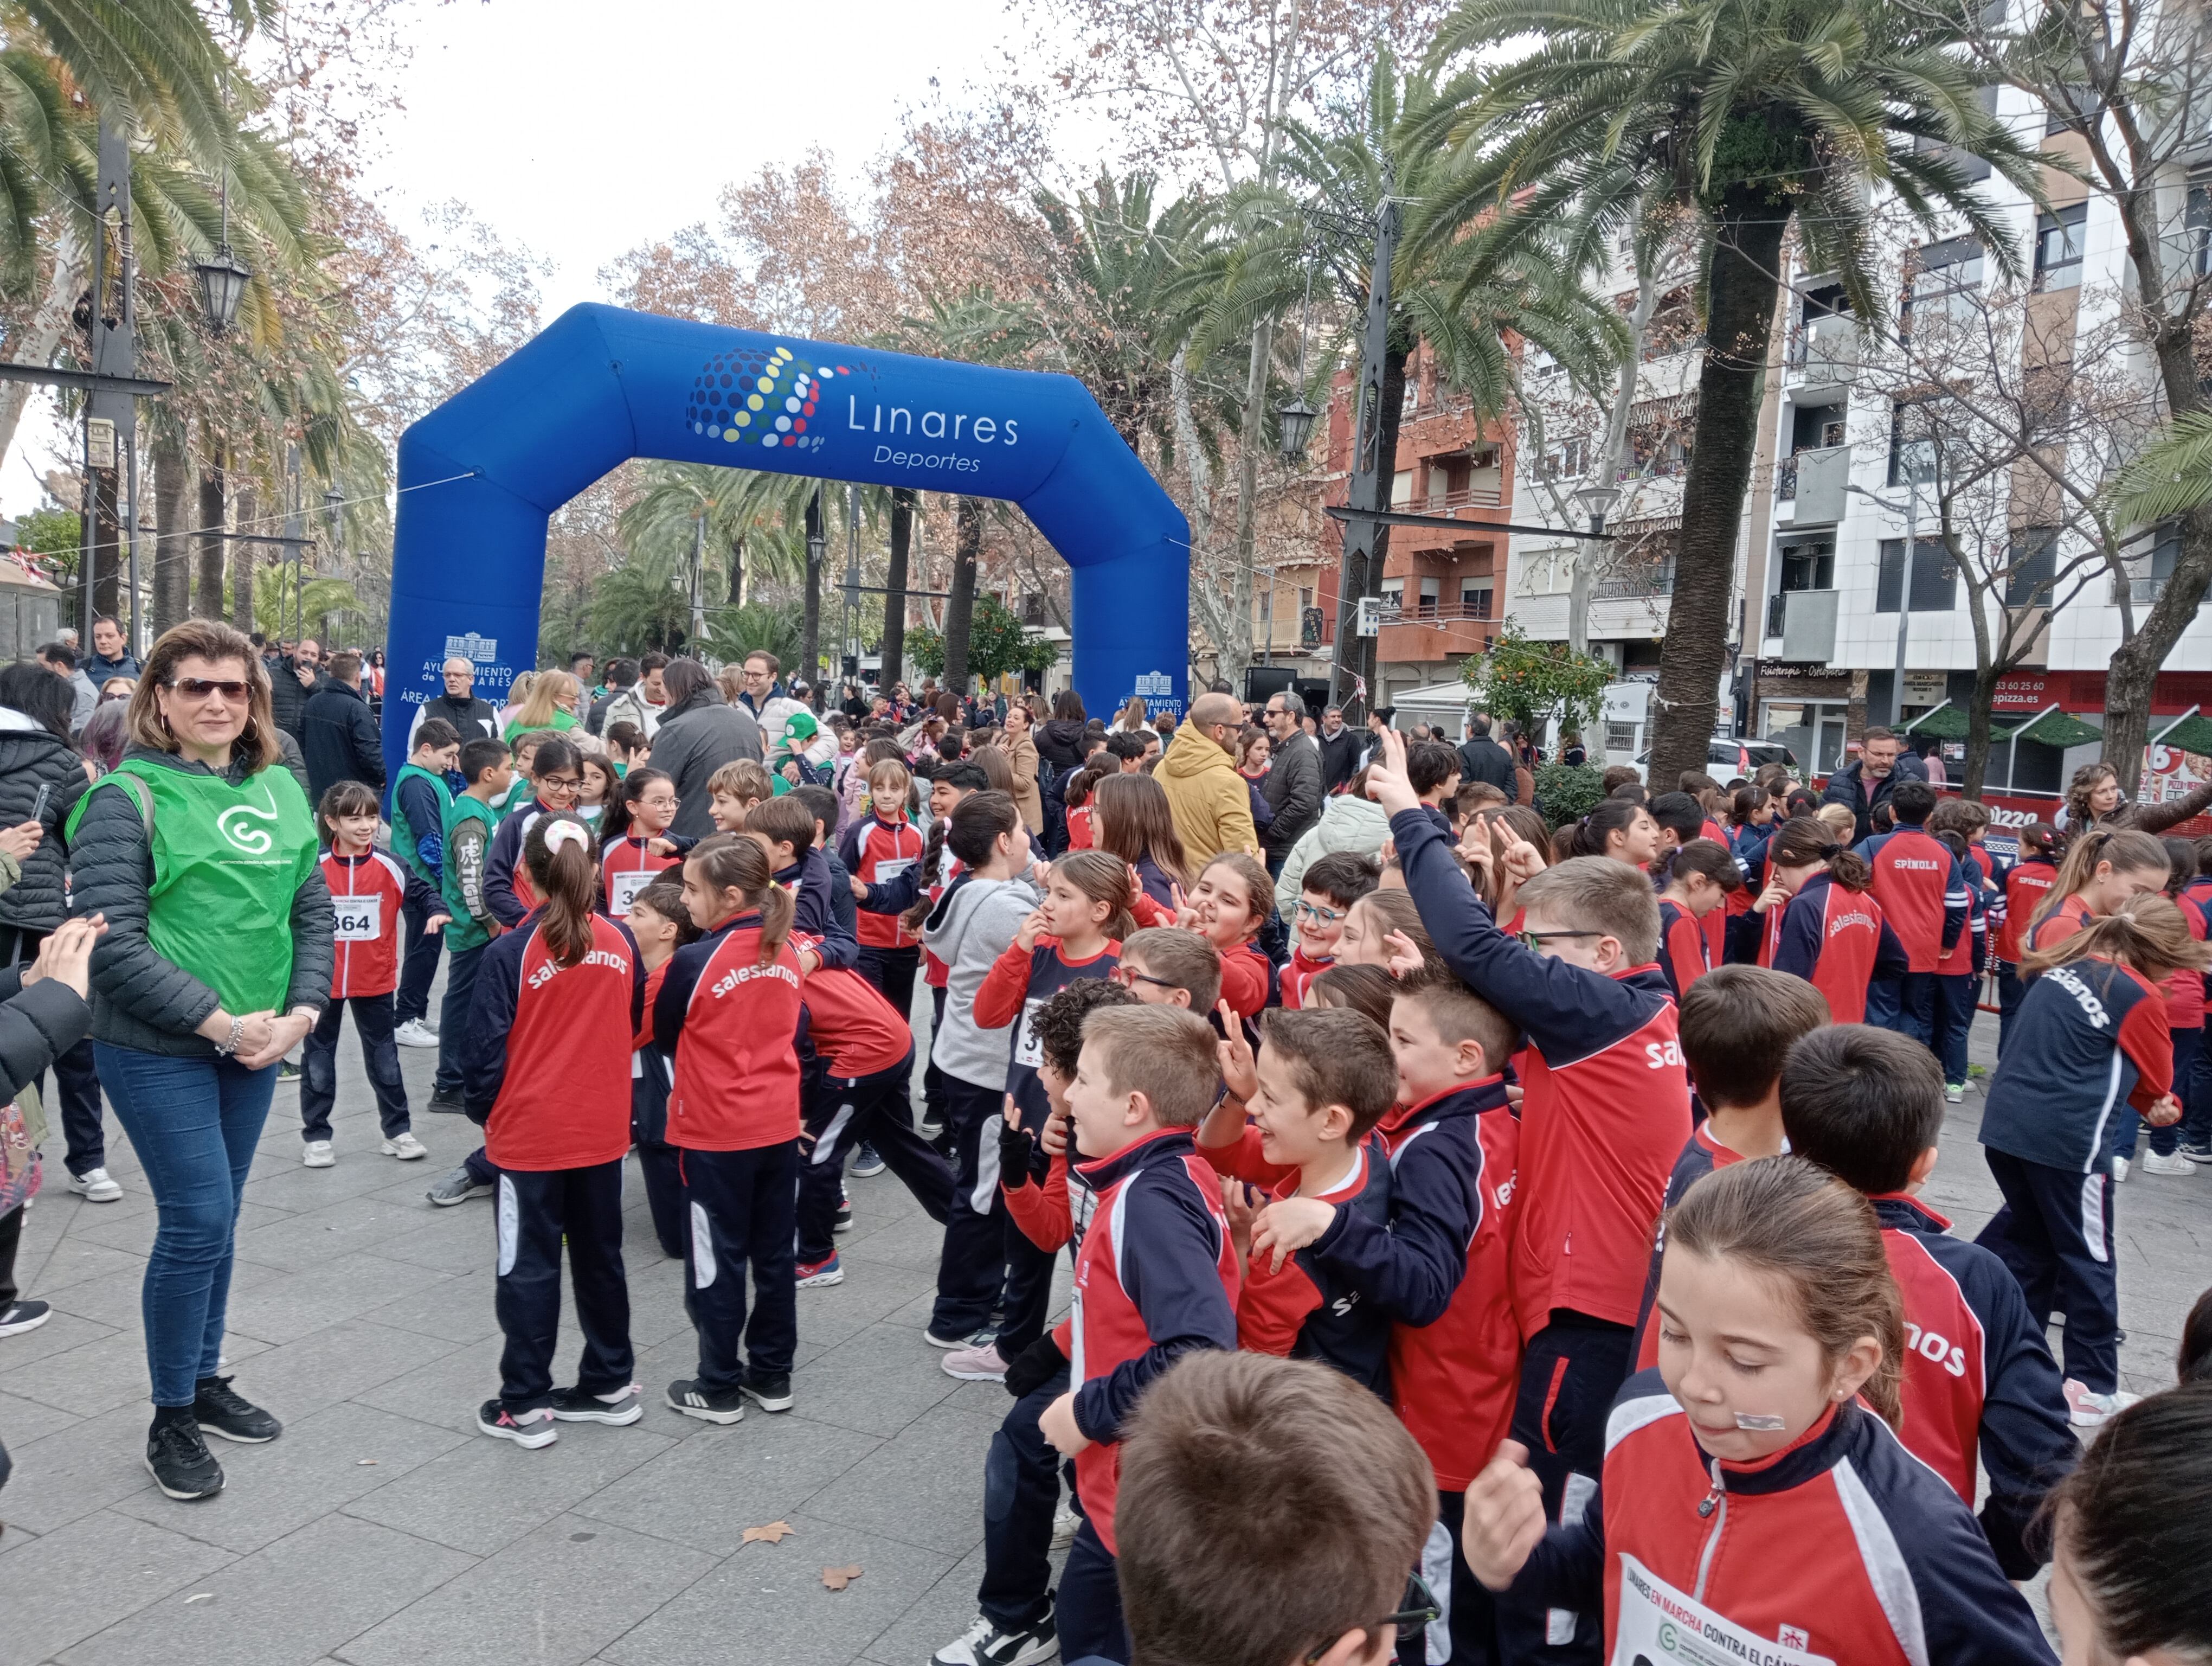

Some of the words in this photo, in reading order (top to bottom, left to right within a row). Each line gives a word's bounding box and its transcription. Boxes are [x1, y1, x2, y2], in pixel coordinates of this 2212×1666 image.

[849, 394, 1018, 445] Linares
[874, 445, 980, 472] Deportes
[422, 671, 435, 682] de
[423, 662, 512, 677] AYUMIENTO
[1760, 665, 1801, 678] Fisioterapia
[400, 688, 430, 705] ÁREA
[2008, 682, 2018, 690] 60
[2021, 682, 2030, 690] 25
[2033, 682, 2044, 690] 60
[460, 837, 481, 865] 虎
[462, 866, 483, 917] TIGER
[528, 950, 628, 989] salanos
[711, 959, 799, 999] salesianos
[1645, 1033, 1687, 1069] sal
[1650, 1589, 1663, 1607] EN
[1662, 1597, 1702, 1634] MARCHA
[1703, 1623, 1747, 1659] CONTRA
[1748, 1648, 1761, 1666] EL
